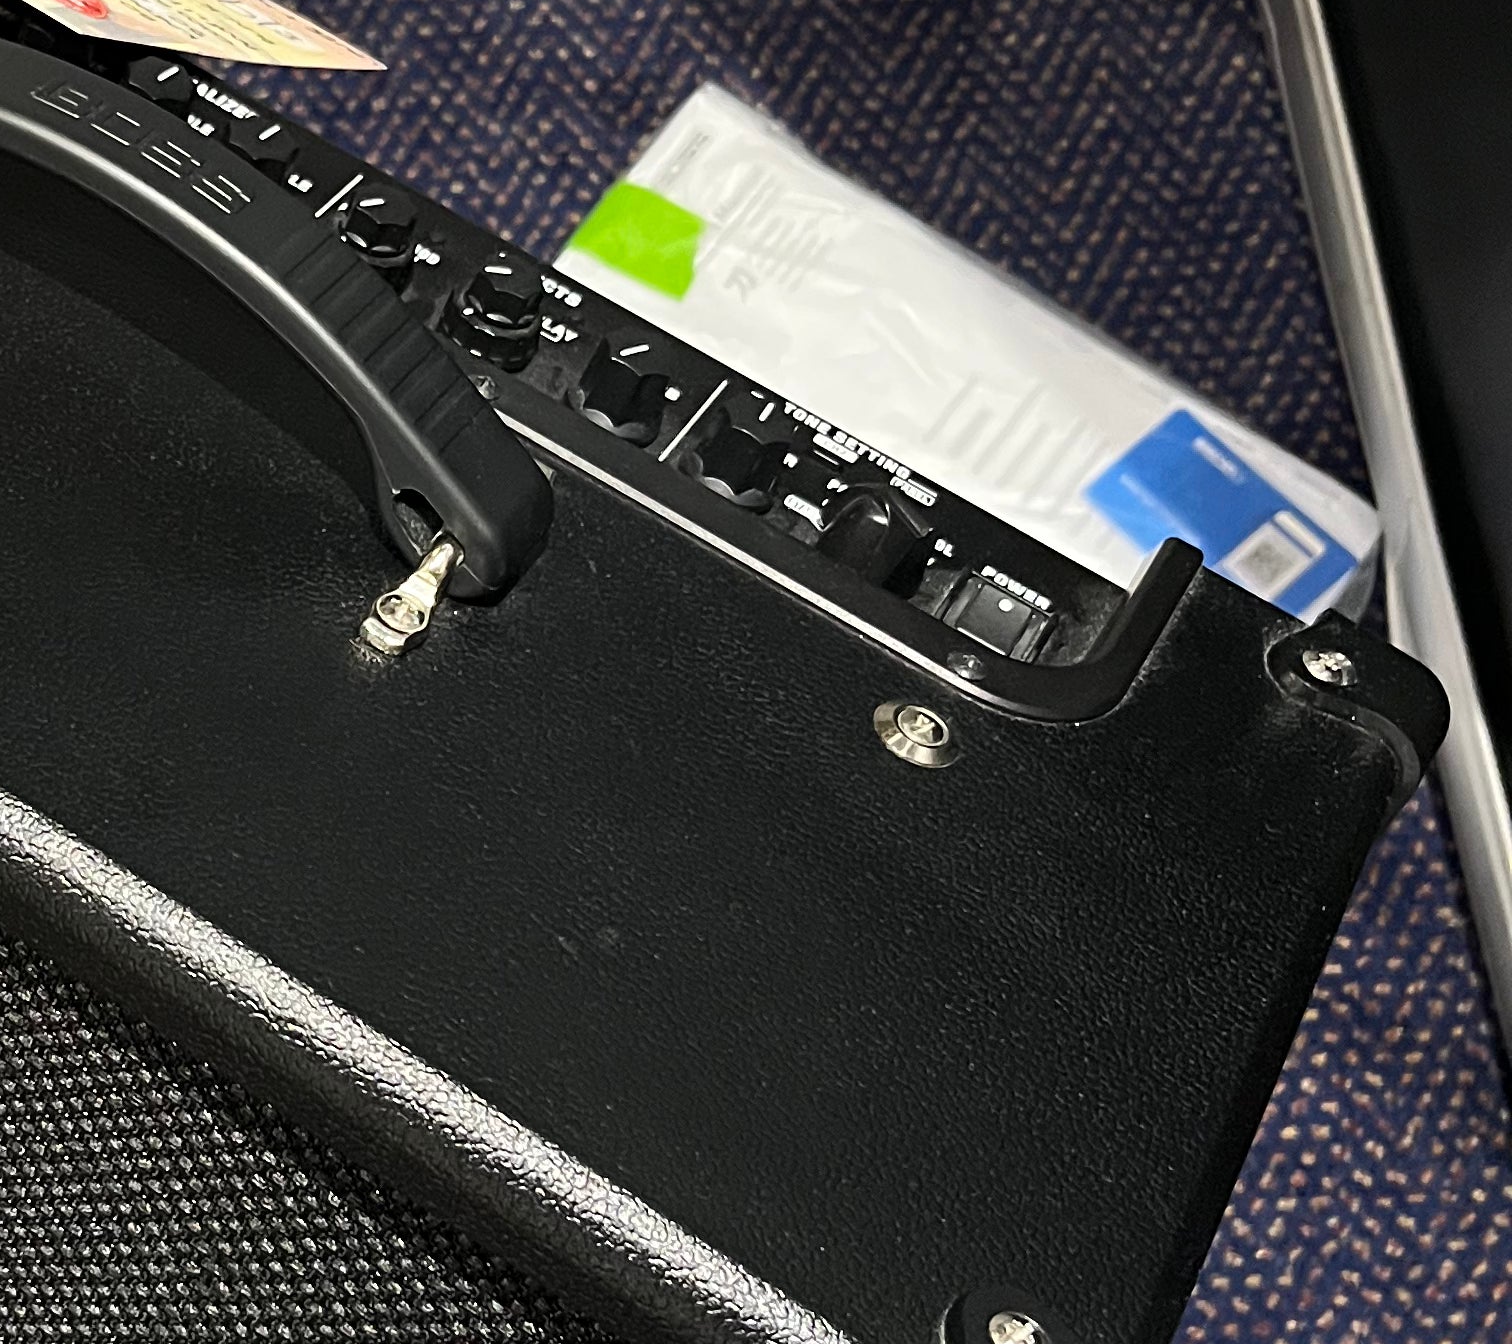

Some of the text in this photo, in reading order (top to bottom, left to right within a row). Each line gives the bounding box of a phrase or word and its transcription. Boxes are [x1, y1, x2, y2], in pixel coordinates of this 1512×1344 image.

[784, 401, 912, 480] TONE SETTING
[980, 565, 1055, 611] POWER
